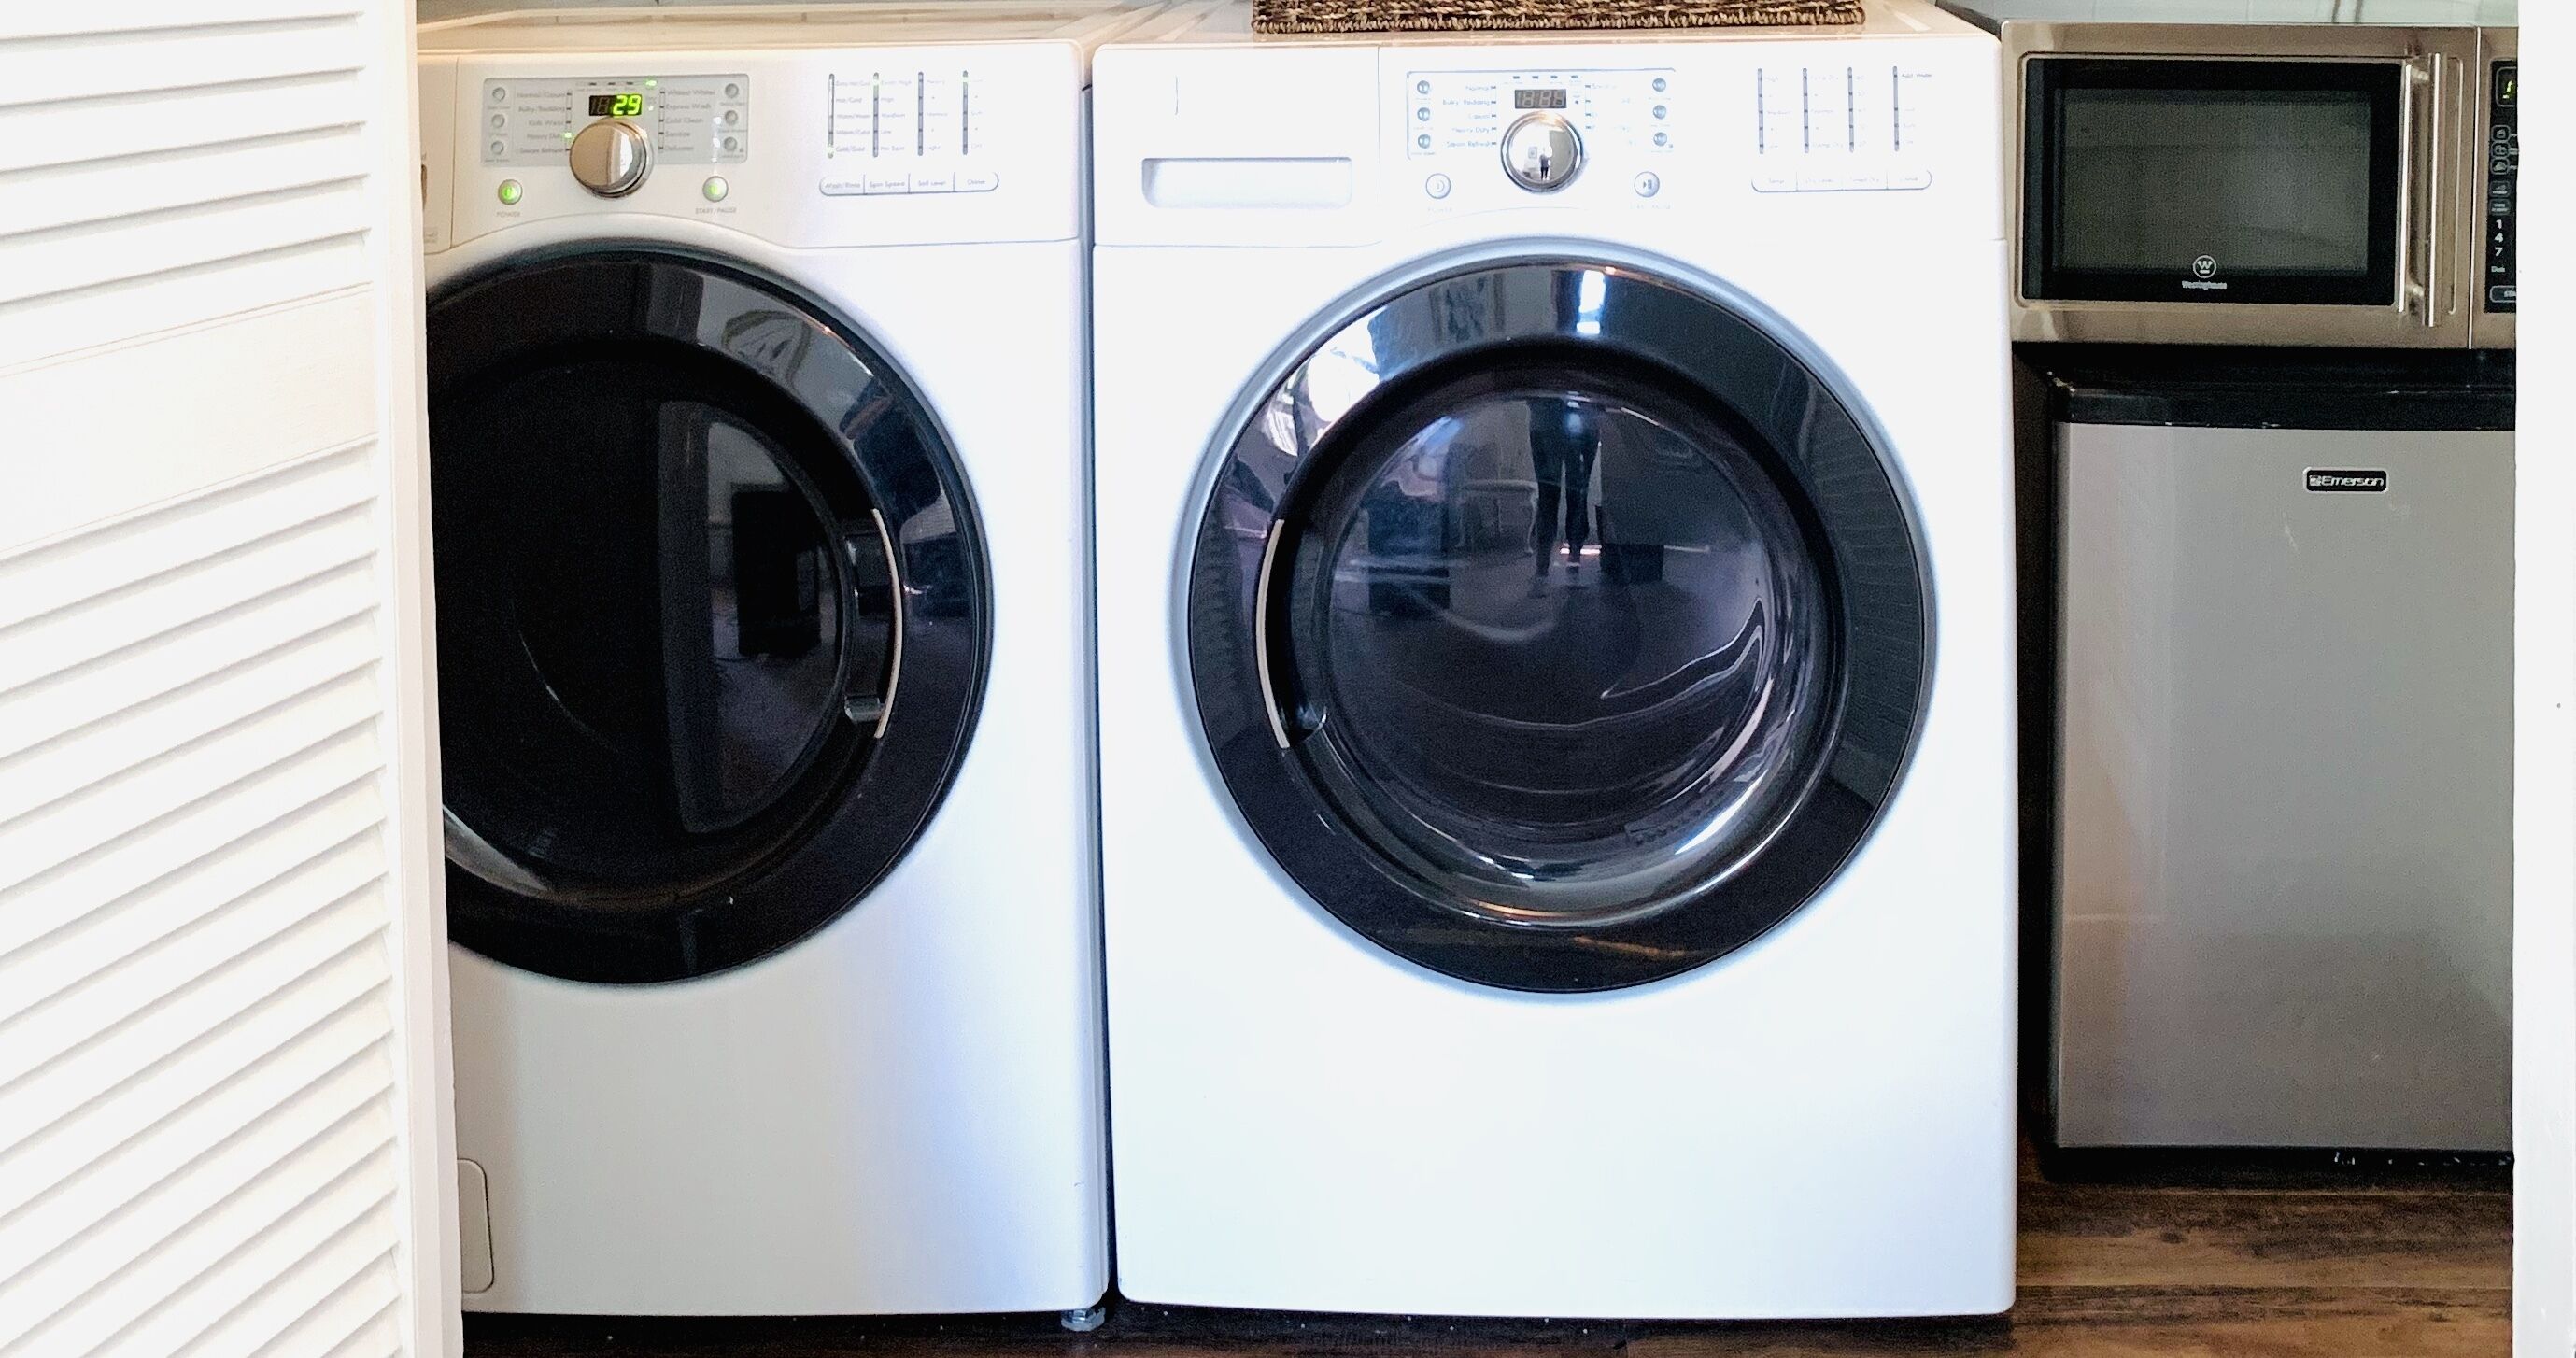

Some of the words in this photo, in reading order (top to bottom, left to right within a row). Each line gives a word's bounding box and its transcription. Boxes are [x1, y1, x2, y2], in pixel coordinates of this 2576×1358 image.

[2496, 219, 2503, 229] 1
[2494, 233, 2504, 243] 4
[2495, 247, 2503, 256] 7
[2321, 474, 2385, 487] Emerson
